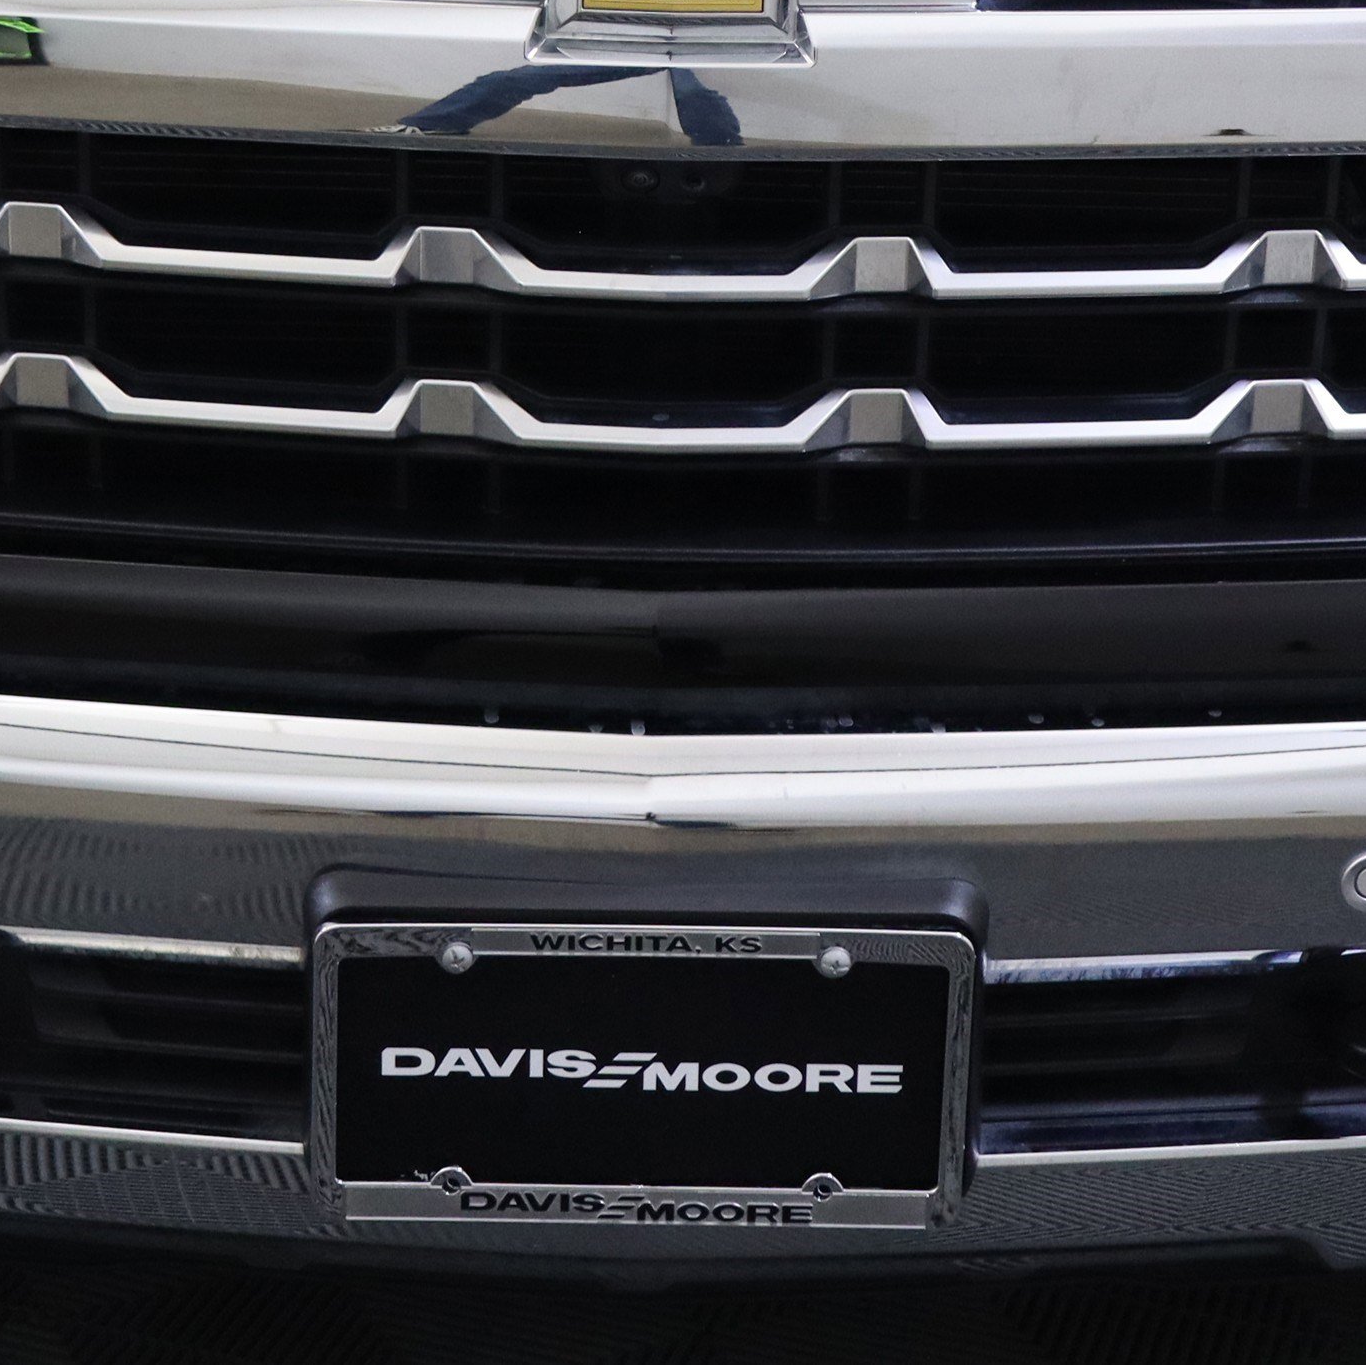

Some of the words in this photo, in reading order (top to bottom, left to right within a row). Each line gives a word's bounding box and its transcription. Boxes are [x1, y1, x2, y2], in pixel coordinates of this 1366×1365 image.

[715, 936, 762, 953] KS
[380, 1046, 597, 1079] DAVIS
[642, 1062, 904, 1094] MOORE
[460, 1192, 606, 1213] DAVIS
[637, 1202, 813, 1224] MOORE
